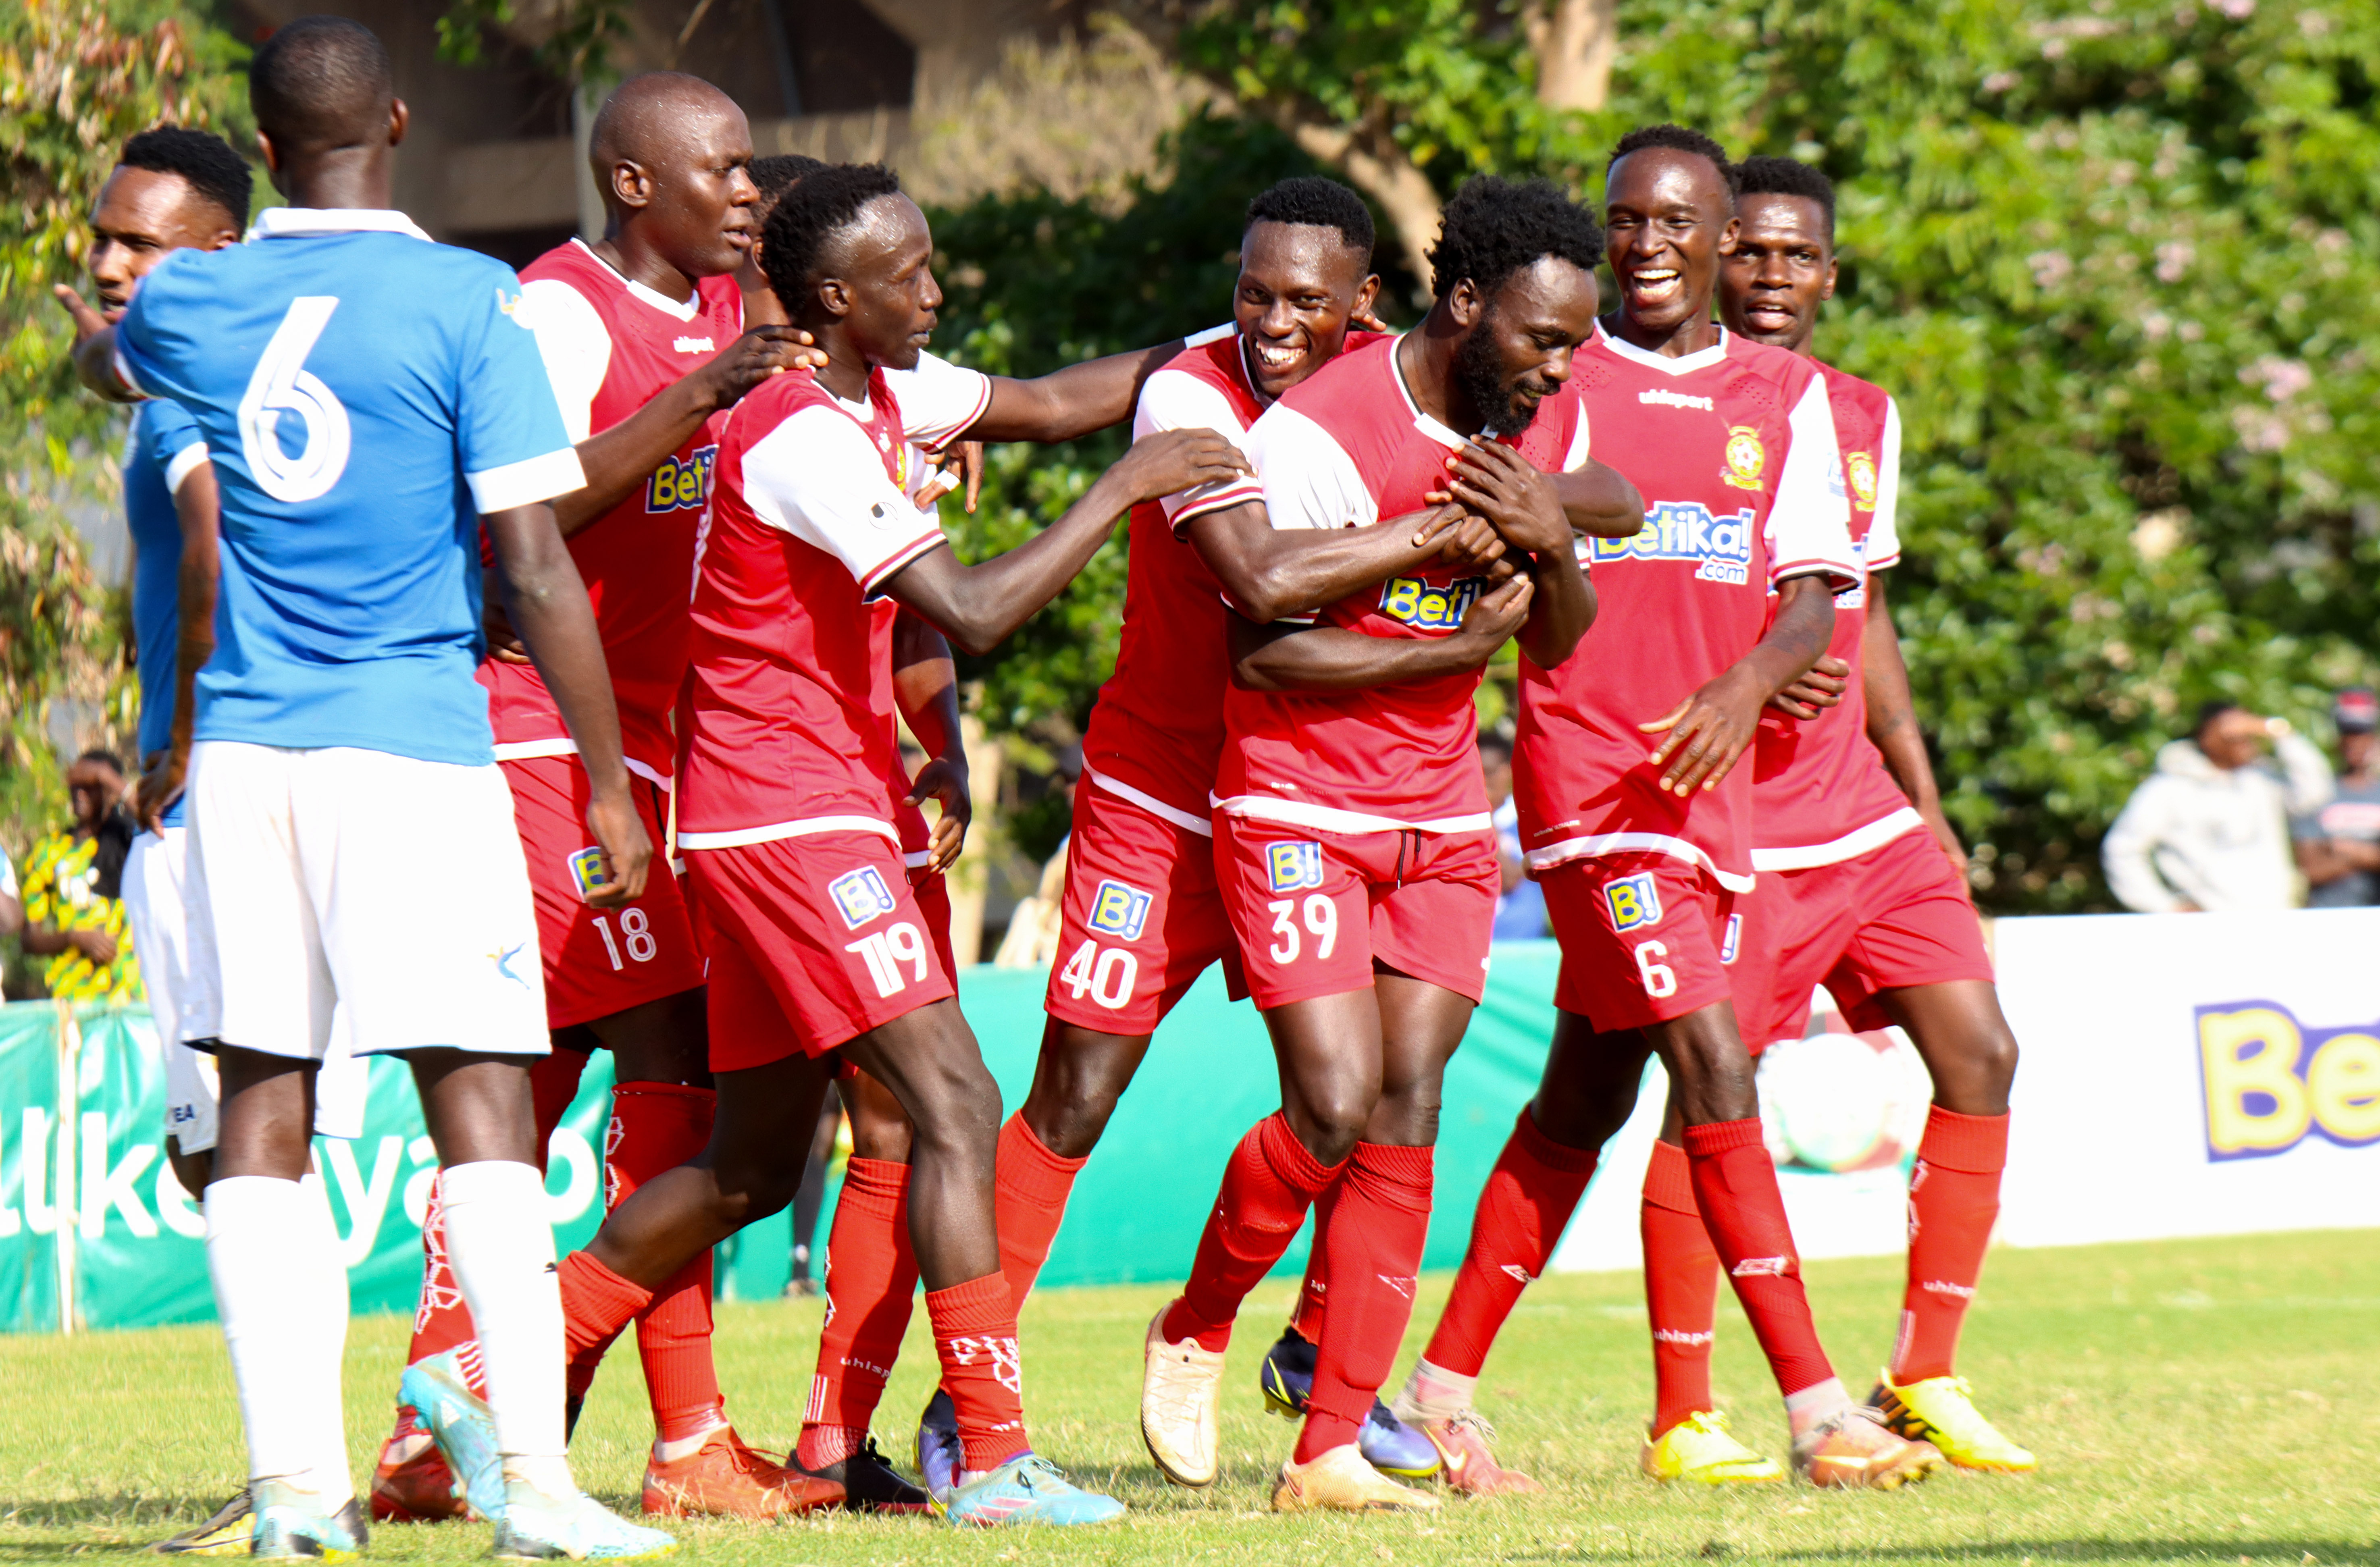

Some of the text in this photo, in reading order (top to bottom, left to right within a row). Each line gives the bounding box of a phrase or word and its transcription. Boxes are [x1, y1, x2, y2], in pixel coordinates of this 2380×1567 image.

[237, 295, 351, 503] 6
[1639, 389, 1714, 411] uhlsport
[1272, 844, 1317, 886] B!
[836, 872, 890, 921] B!
[1095, 887, 1145, 935] B!
[1609, 880, 1656, 925] B!
[591, 907, 657, 971] 18
[1268, 893, 1338, 964] 39
[844, 922, 928, 998] 19
[1060, 939, 1138, 1009] 40
[1634, 939, 1679, 999] 6
